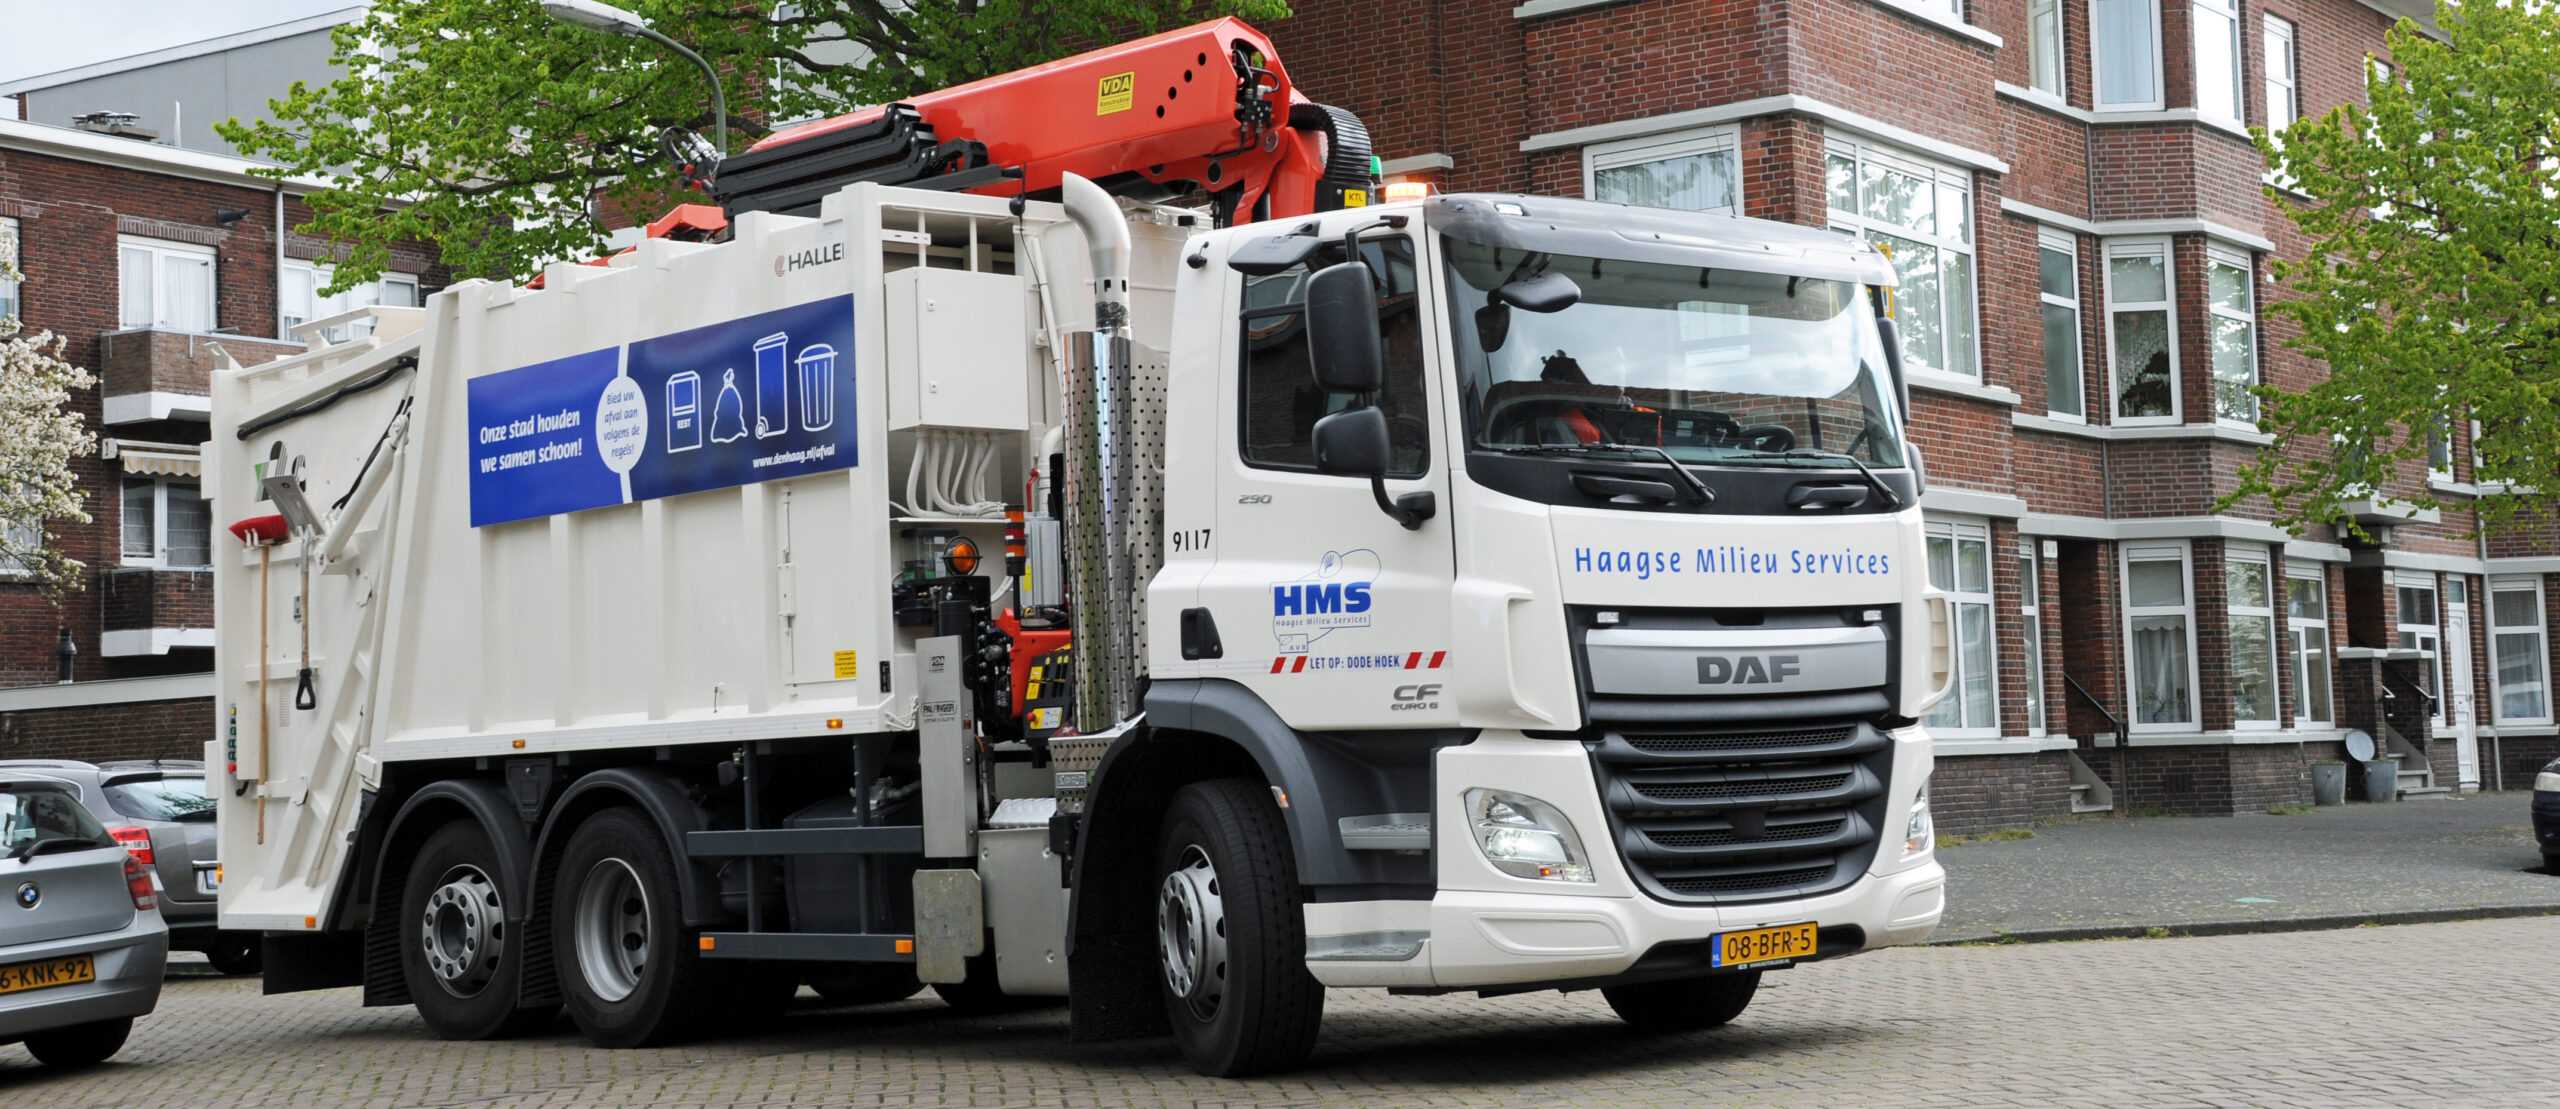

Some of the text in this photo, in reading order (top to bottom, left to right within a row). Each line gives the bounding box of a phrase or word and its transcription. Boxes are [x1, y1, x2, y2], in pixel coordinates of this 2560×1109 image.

[1102, 75, 1131, 95] VDA
[788, 242, 845, 272] HALLE
[606, 391, 635, 405] Bied uw
[480, 408, 580, 444] Onze stad houden
[604, 408, 638, 425] afval aan
[676, 418, 691, 430] REST
[603, 424, 640, 443] volgens de
[480, 437, 583, 473] we samen schoon!
[611, 443, 635, 460] regels!
[752, 443, 836, 469] www.denhaag.nl/afval
[1238, 494, 1273, 504] 290
[1172, 528, 1211, 552] 9117
[1575, 546, 1890, 579] Haagse Milieu Services
[1274, 582, 1371, 616] HMS
[1275, 615, 1368, 628] Haagse Milieu Services
[1310, 655, 1400, 669] LET OP: DODE HOEK
[1696, 655, 1800, 684] DAF
[1393, 683, 1443, 701] CF
[1727, 928, 1811, 960] 08-BFR-5
[0, 960, 89, 990] 6-KNK-92
